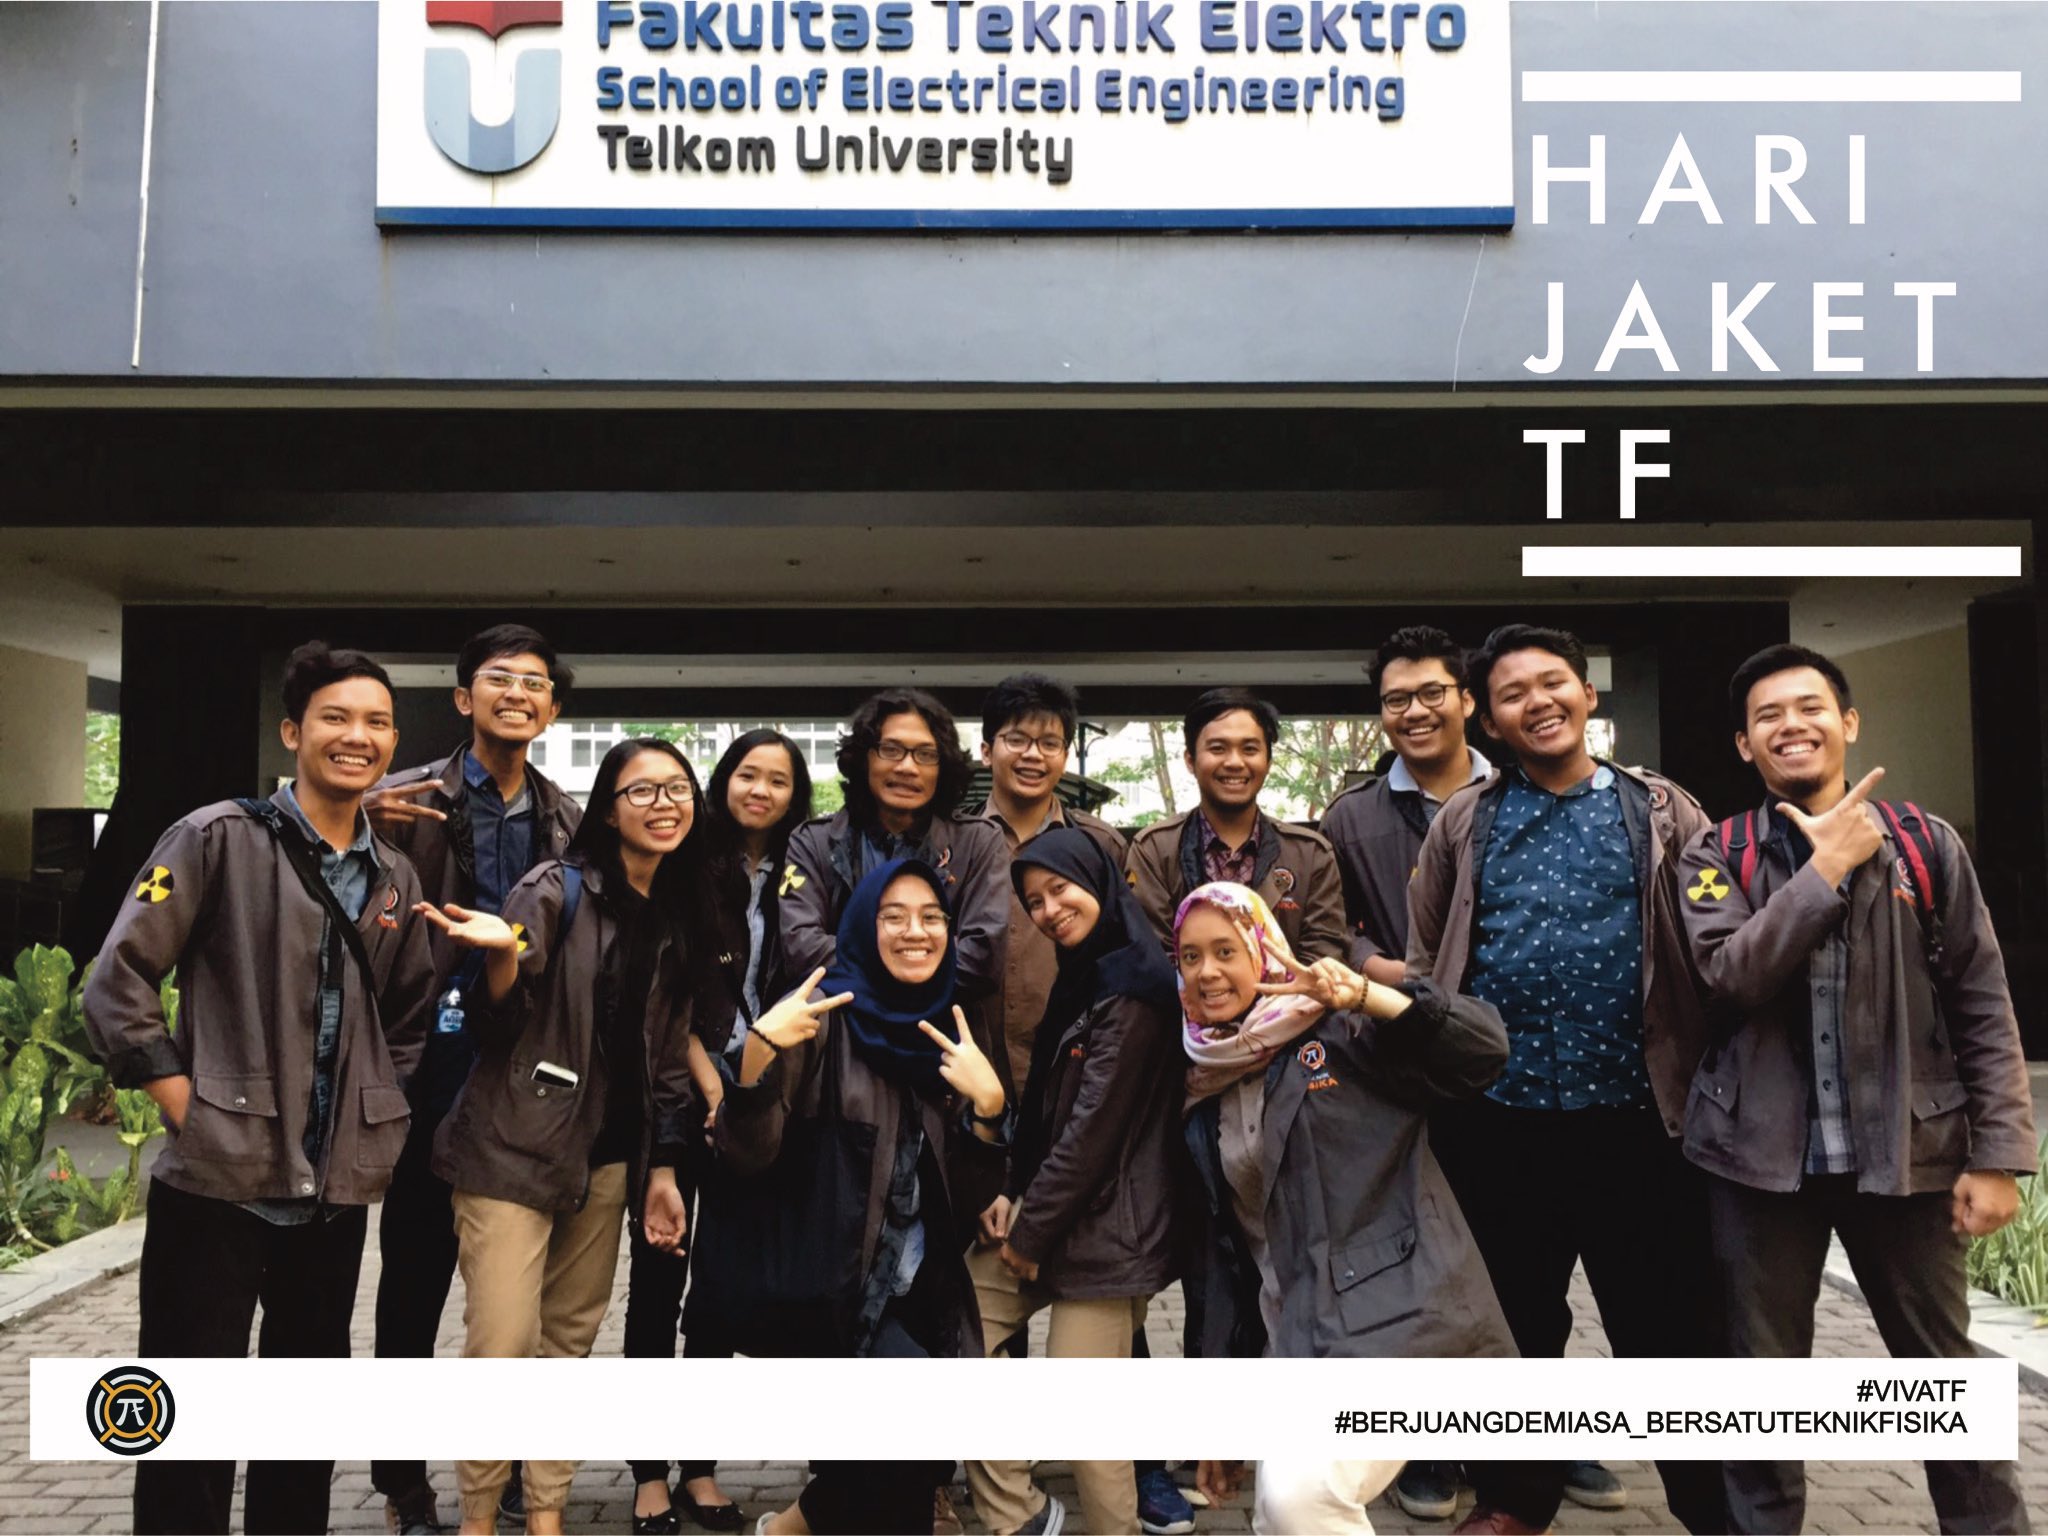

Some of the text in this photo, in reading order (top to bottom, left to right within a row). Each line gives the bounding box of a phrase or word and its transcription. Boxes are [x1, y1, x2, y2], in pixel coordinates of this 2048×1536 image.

[598, 0, 1467, 52] Fakultas Teknik Elektro
[596, 65, 1405, 123] School of Electrical Engineering
[597, 125, 1073, 184] Telkom University
